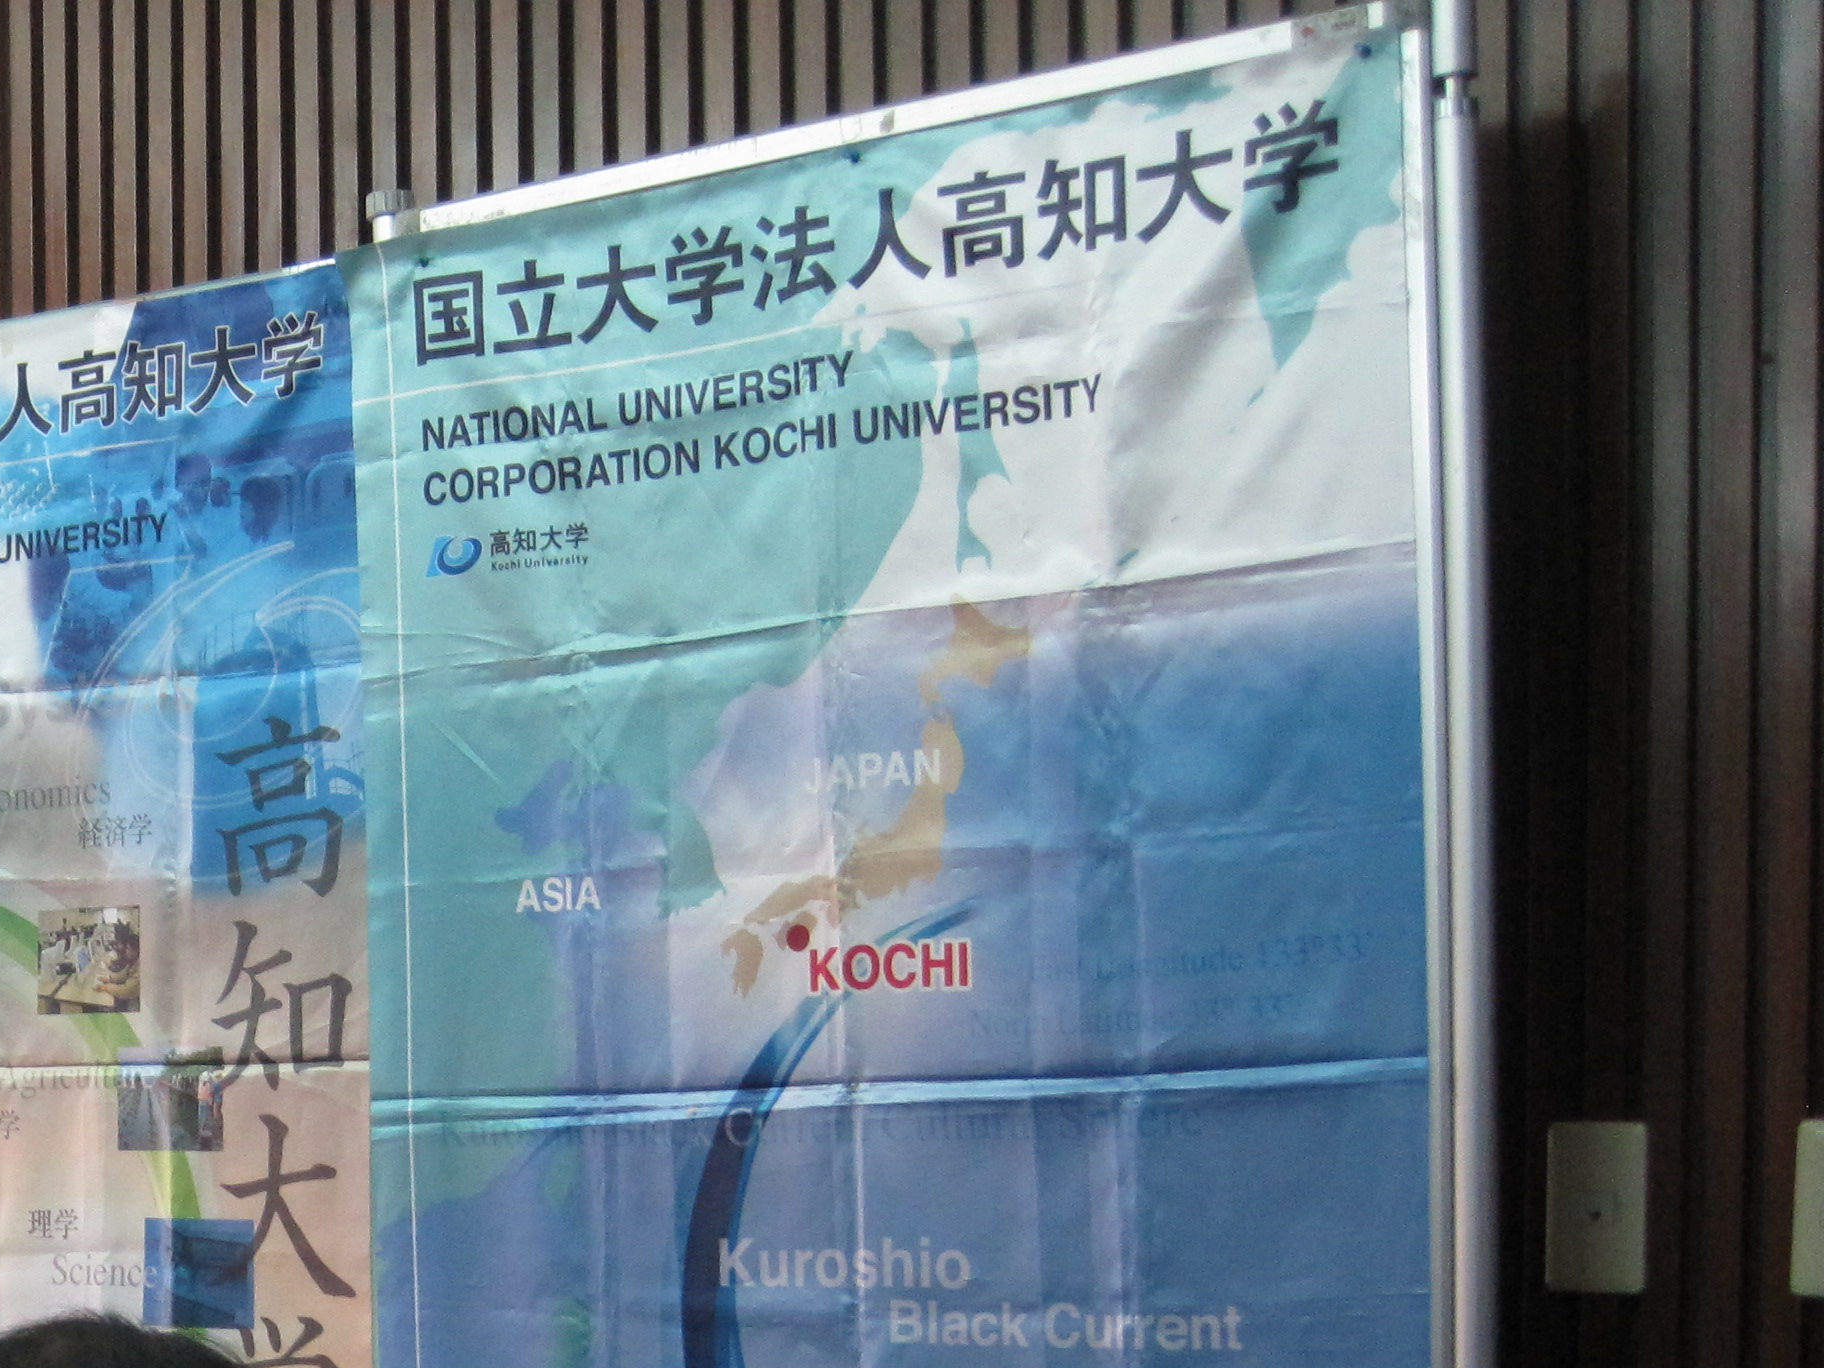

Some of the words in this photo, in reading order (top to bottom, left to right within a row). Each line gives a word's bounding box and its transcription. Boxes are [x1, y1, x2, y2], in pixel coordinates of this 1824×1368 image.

[413, 100, 1340, 366] 国立大学法人高知大学
[422, 395, 608, 452] NATIONAL
[618, 350, 854, 428] UNIVERSITY
[422, 432, 702, 506] CORPORATION
[713, 416, 838, 471] KOCHI
[853, 373, 1103, 446] UNIVERSITY
[489, 521, 589, 558] 高知大学
[490, 559, 521, 572] Kochi
[524, 554, 589, 569] University
[804, 747, 942, 797] JAPAN
[515, 876, 602, 916] ASIA
[807, 941, 973, 995] KOCHI
[51, 1251, 159, 1289] Science
[717, 1236, 972, 1291] Kuroshio
[887, 1299, 1030, 1348] Black
[1043, 1303, 1243, 1351] Current
